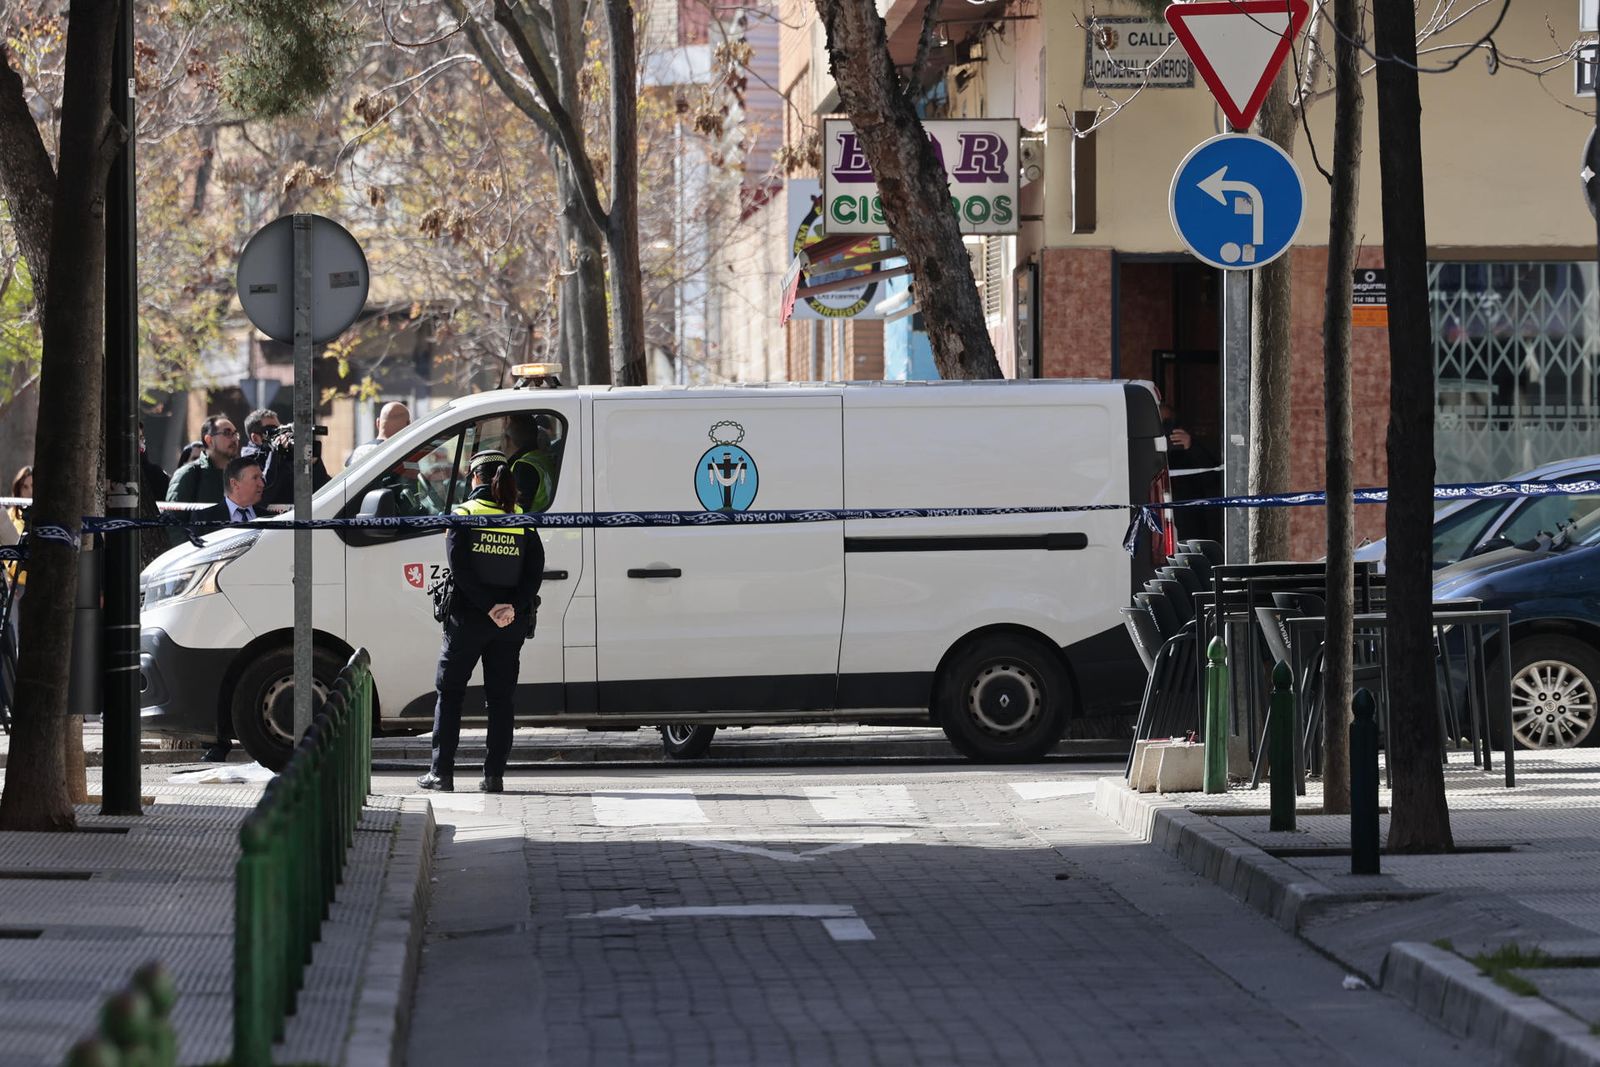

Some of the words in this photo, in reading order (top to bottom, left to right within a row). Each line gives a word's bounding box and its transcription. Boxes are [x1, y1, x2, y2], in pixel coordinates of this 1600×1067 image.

[1094, 60, 1142, 78] CARDENAL
[1144, 60, 1187, 78] CISNEROS
[832, 131, 1009, 184] BR
[734, 512, 767, 522] PASAR
[769, 512, 786, 521] NO
[961, 508, 978, 516] NO
[349, 518, 382, 526] PASAR
[383, 517, 400, 526] NO
[541, 515, 574, 525] PASAR
[576, 515, 593, 524] NO
[481, 533, 516, 545] POLICIA
[472, 542, 520, 556] ZARAGOZA
